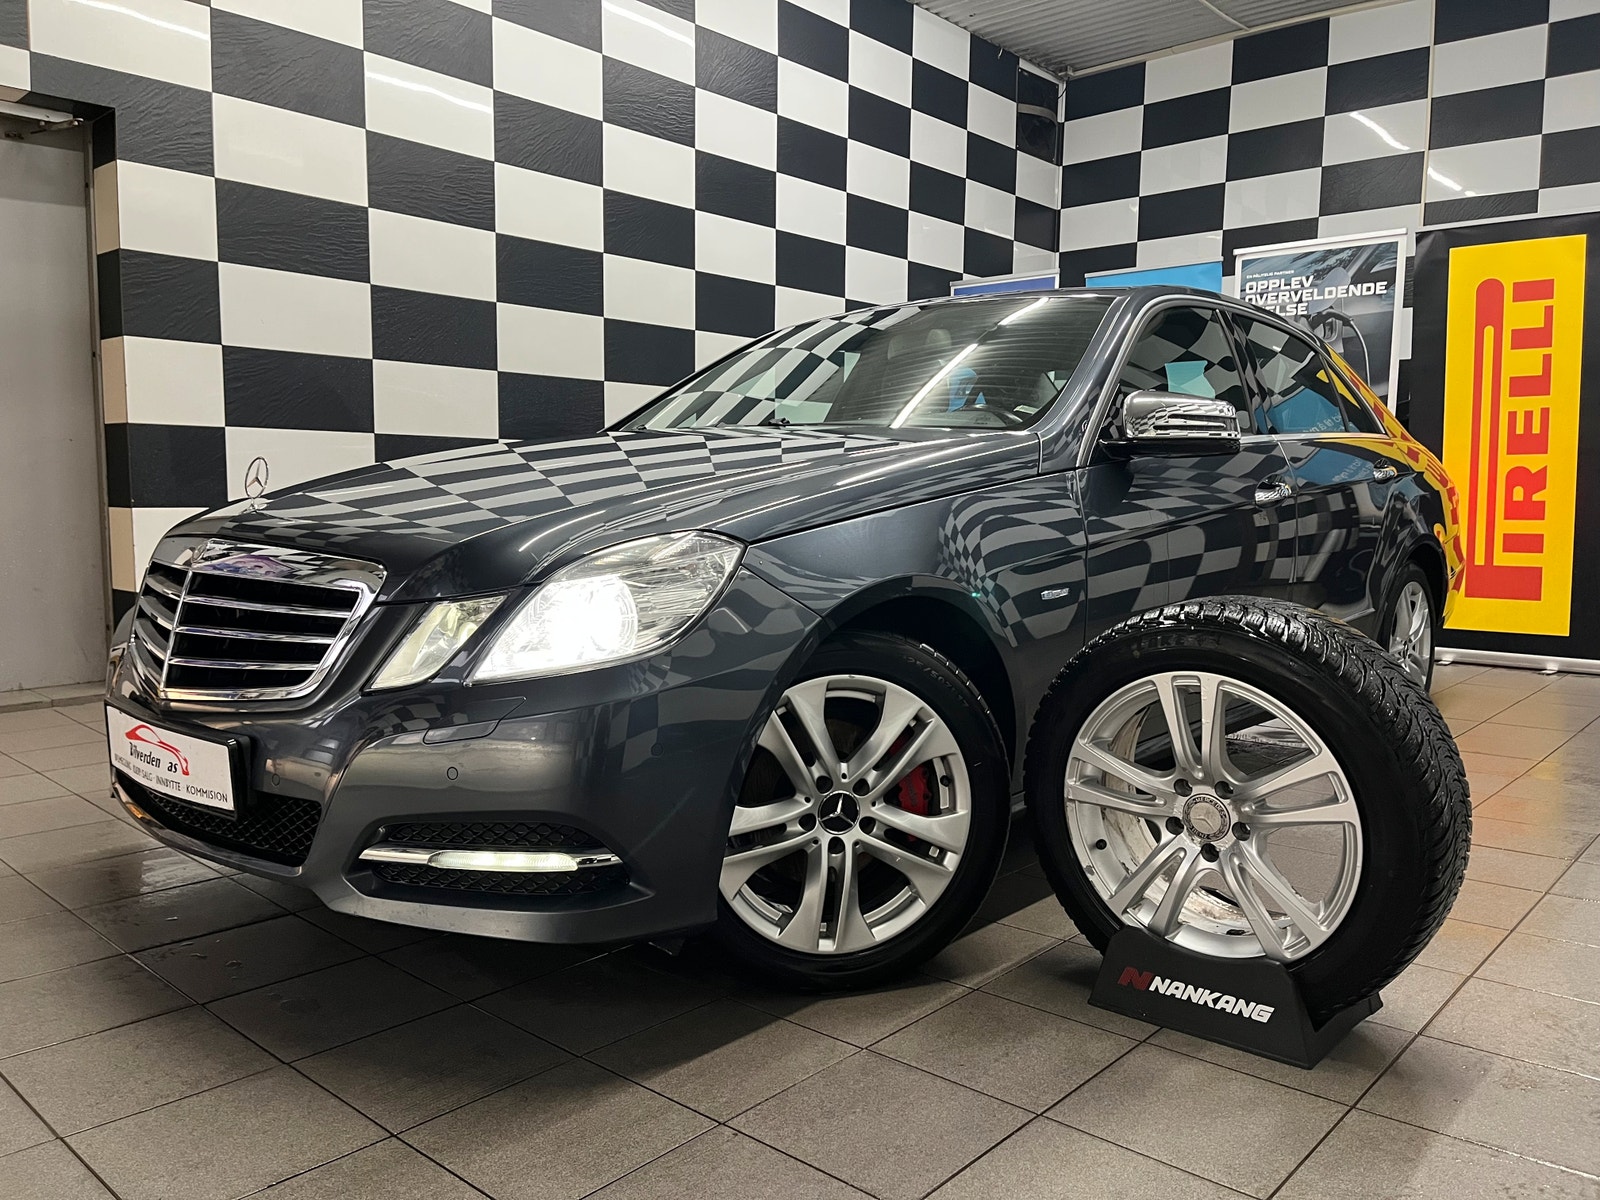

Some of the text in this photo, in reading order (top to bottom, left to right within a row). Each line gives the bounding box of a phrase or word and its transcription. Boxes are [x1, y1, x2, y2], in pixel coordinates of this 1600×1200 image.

[1245, 275, 1314, 294] OPPLEV
[1245, 282, 1388, 305] OVERVELDENDE
[1464, 278, 1555, 602] PIRELLI
[167, 761, 179, 773] as
[155, 775, 181, 792] INNBYTTE
[186, 784, 228, 803] KOMMISION
[1148, 975, 1275, 1023] NANKANG
